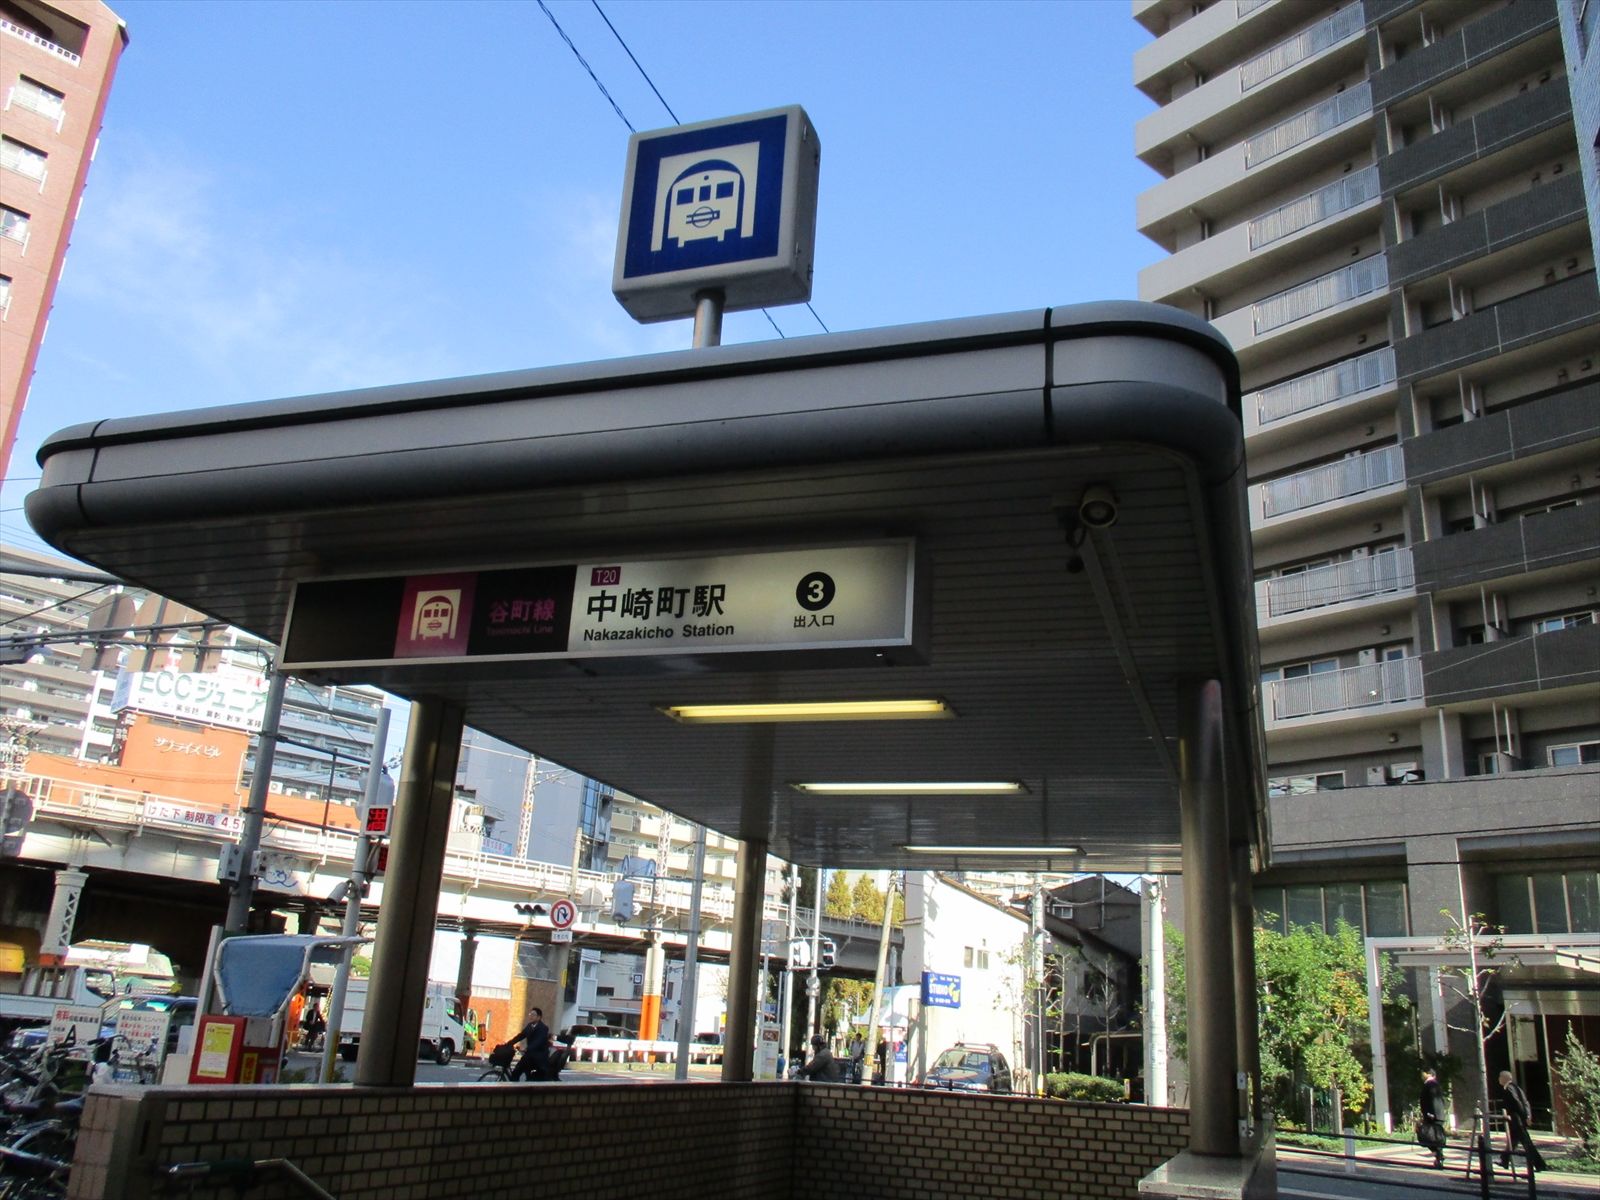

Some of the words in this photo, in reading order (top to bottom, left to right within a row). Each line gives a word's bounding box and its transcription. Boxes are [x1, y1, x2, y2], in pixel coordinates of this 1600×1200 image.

[596, 569, 617, 584] T20
[807, 580, 824, 602] 3
[489, 599, 555, 624] 谷町線
[587, 584, 726, 622] 中崎町駅
[583, 625, 674, 641] Nakazakicho
[683, 623, 735, 638] Station
[793, 614, 834, 628] 出入口
[148, 804, 180, 820] けた下
[184, 810, 216, 826] 制限高
